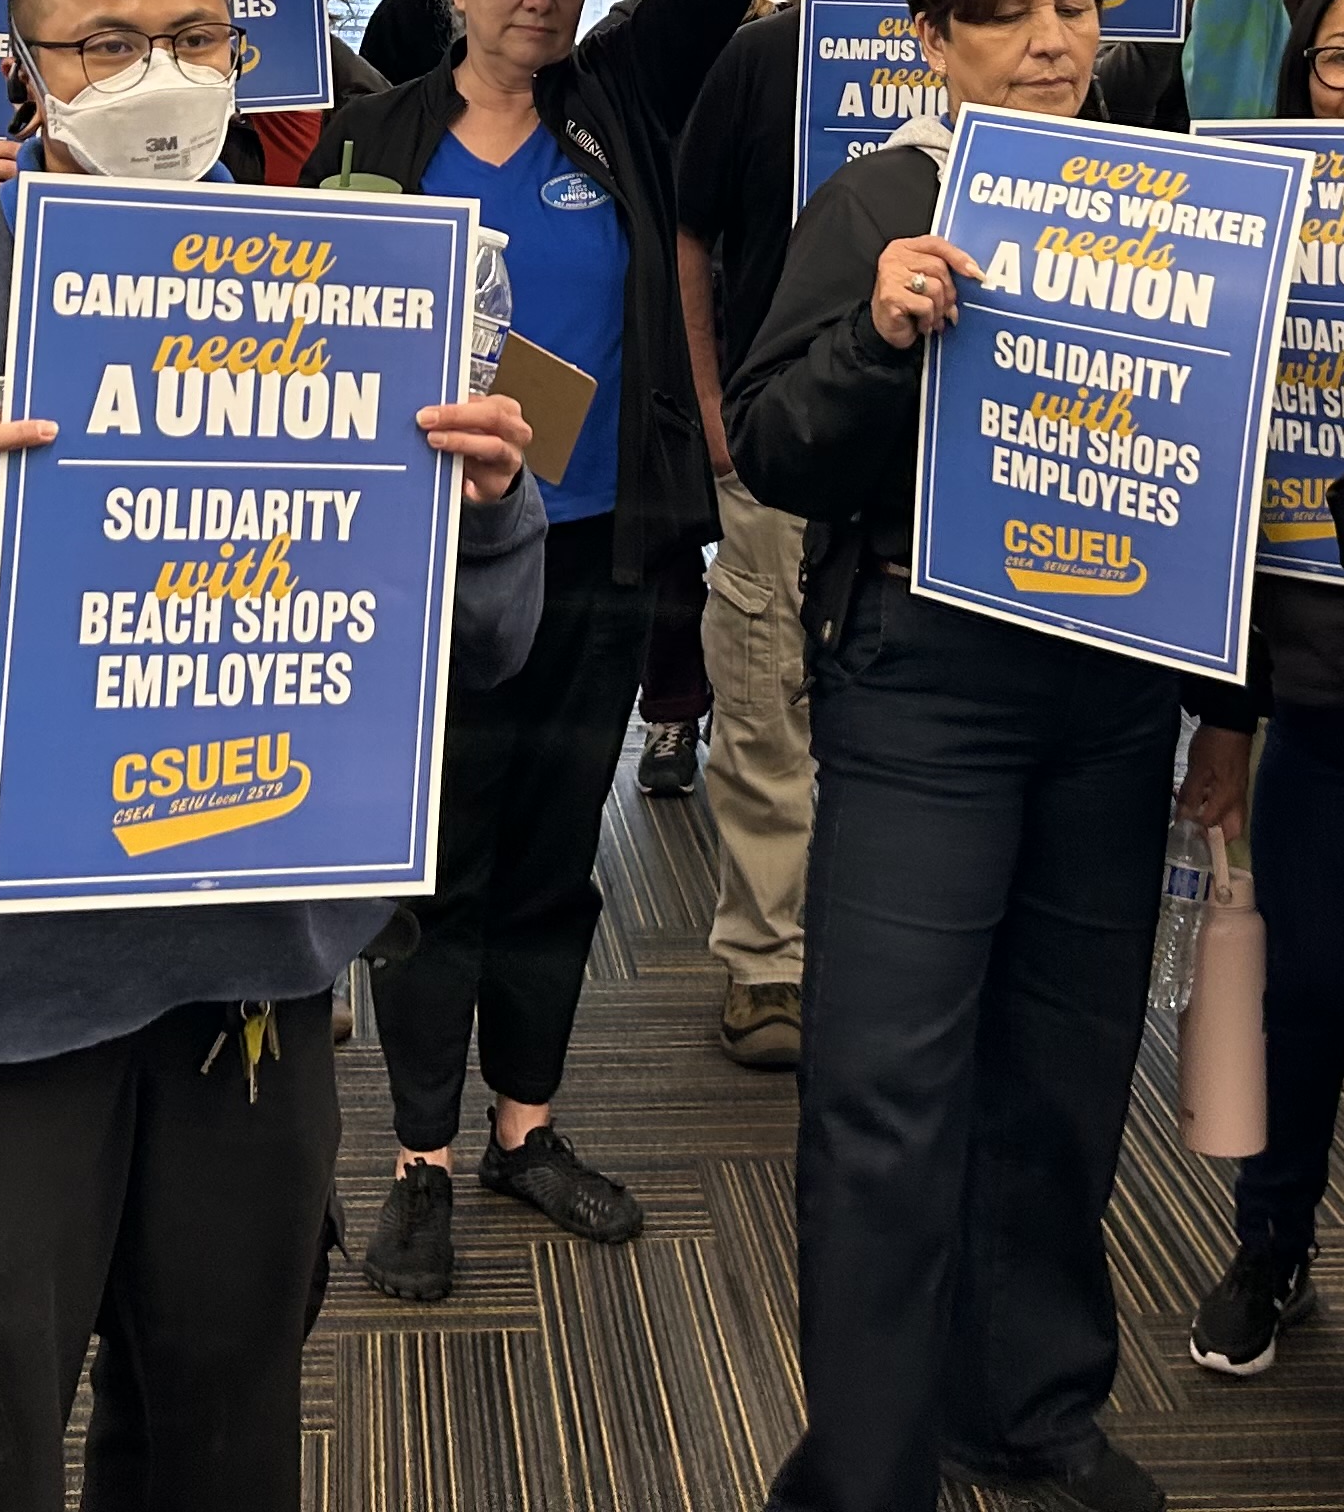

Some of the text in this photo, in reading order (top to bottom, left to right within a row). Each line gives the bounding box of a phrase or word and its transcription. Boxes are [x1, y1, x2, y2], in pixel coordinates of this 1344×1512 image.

[819, 37, 916, 62] CAMPUS
[837, 82, 865, 117] A
[146, 136, 178, 152] 3M
[560, 191, 596, 201] UNION
[1061, 154, 1191, 201] every
[969, 172, 1267, 248] CAMPUS WORKER
[172, 232, 336, 282] every
[1035, 226, 1175, 271] needs
[53, 271, 434, 329] CAMPUS WORKER
[984, 240, 1216, 328] A UNION
[152, 318, 331, 377] needs
[993, 330, 1192, 405] SOLIDARITY
[87, 364, 381, 440] A UNION
[1030, 386, 1139, 437] with
[980, 399, 1200, 485] BEACH SHOPS
[104, 488, 361, 542] SOLIDARITY
[992, 448, 1181, 527] EMPLOYEES
[155, 533, 298, 600] with
[1004, 519, 1131, 566] CSUEU
[79, 590, 377, 646] BEACH SHOPS
[95, 652, 352, 709] EMPLOYEES
[112, 732, 290, 803] CSUEU
[113, 782, 284, 825] CSEA SEIU Local 2579
